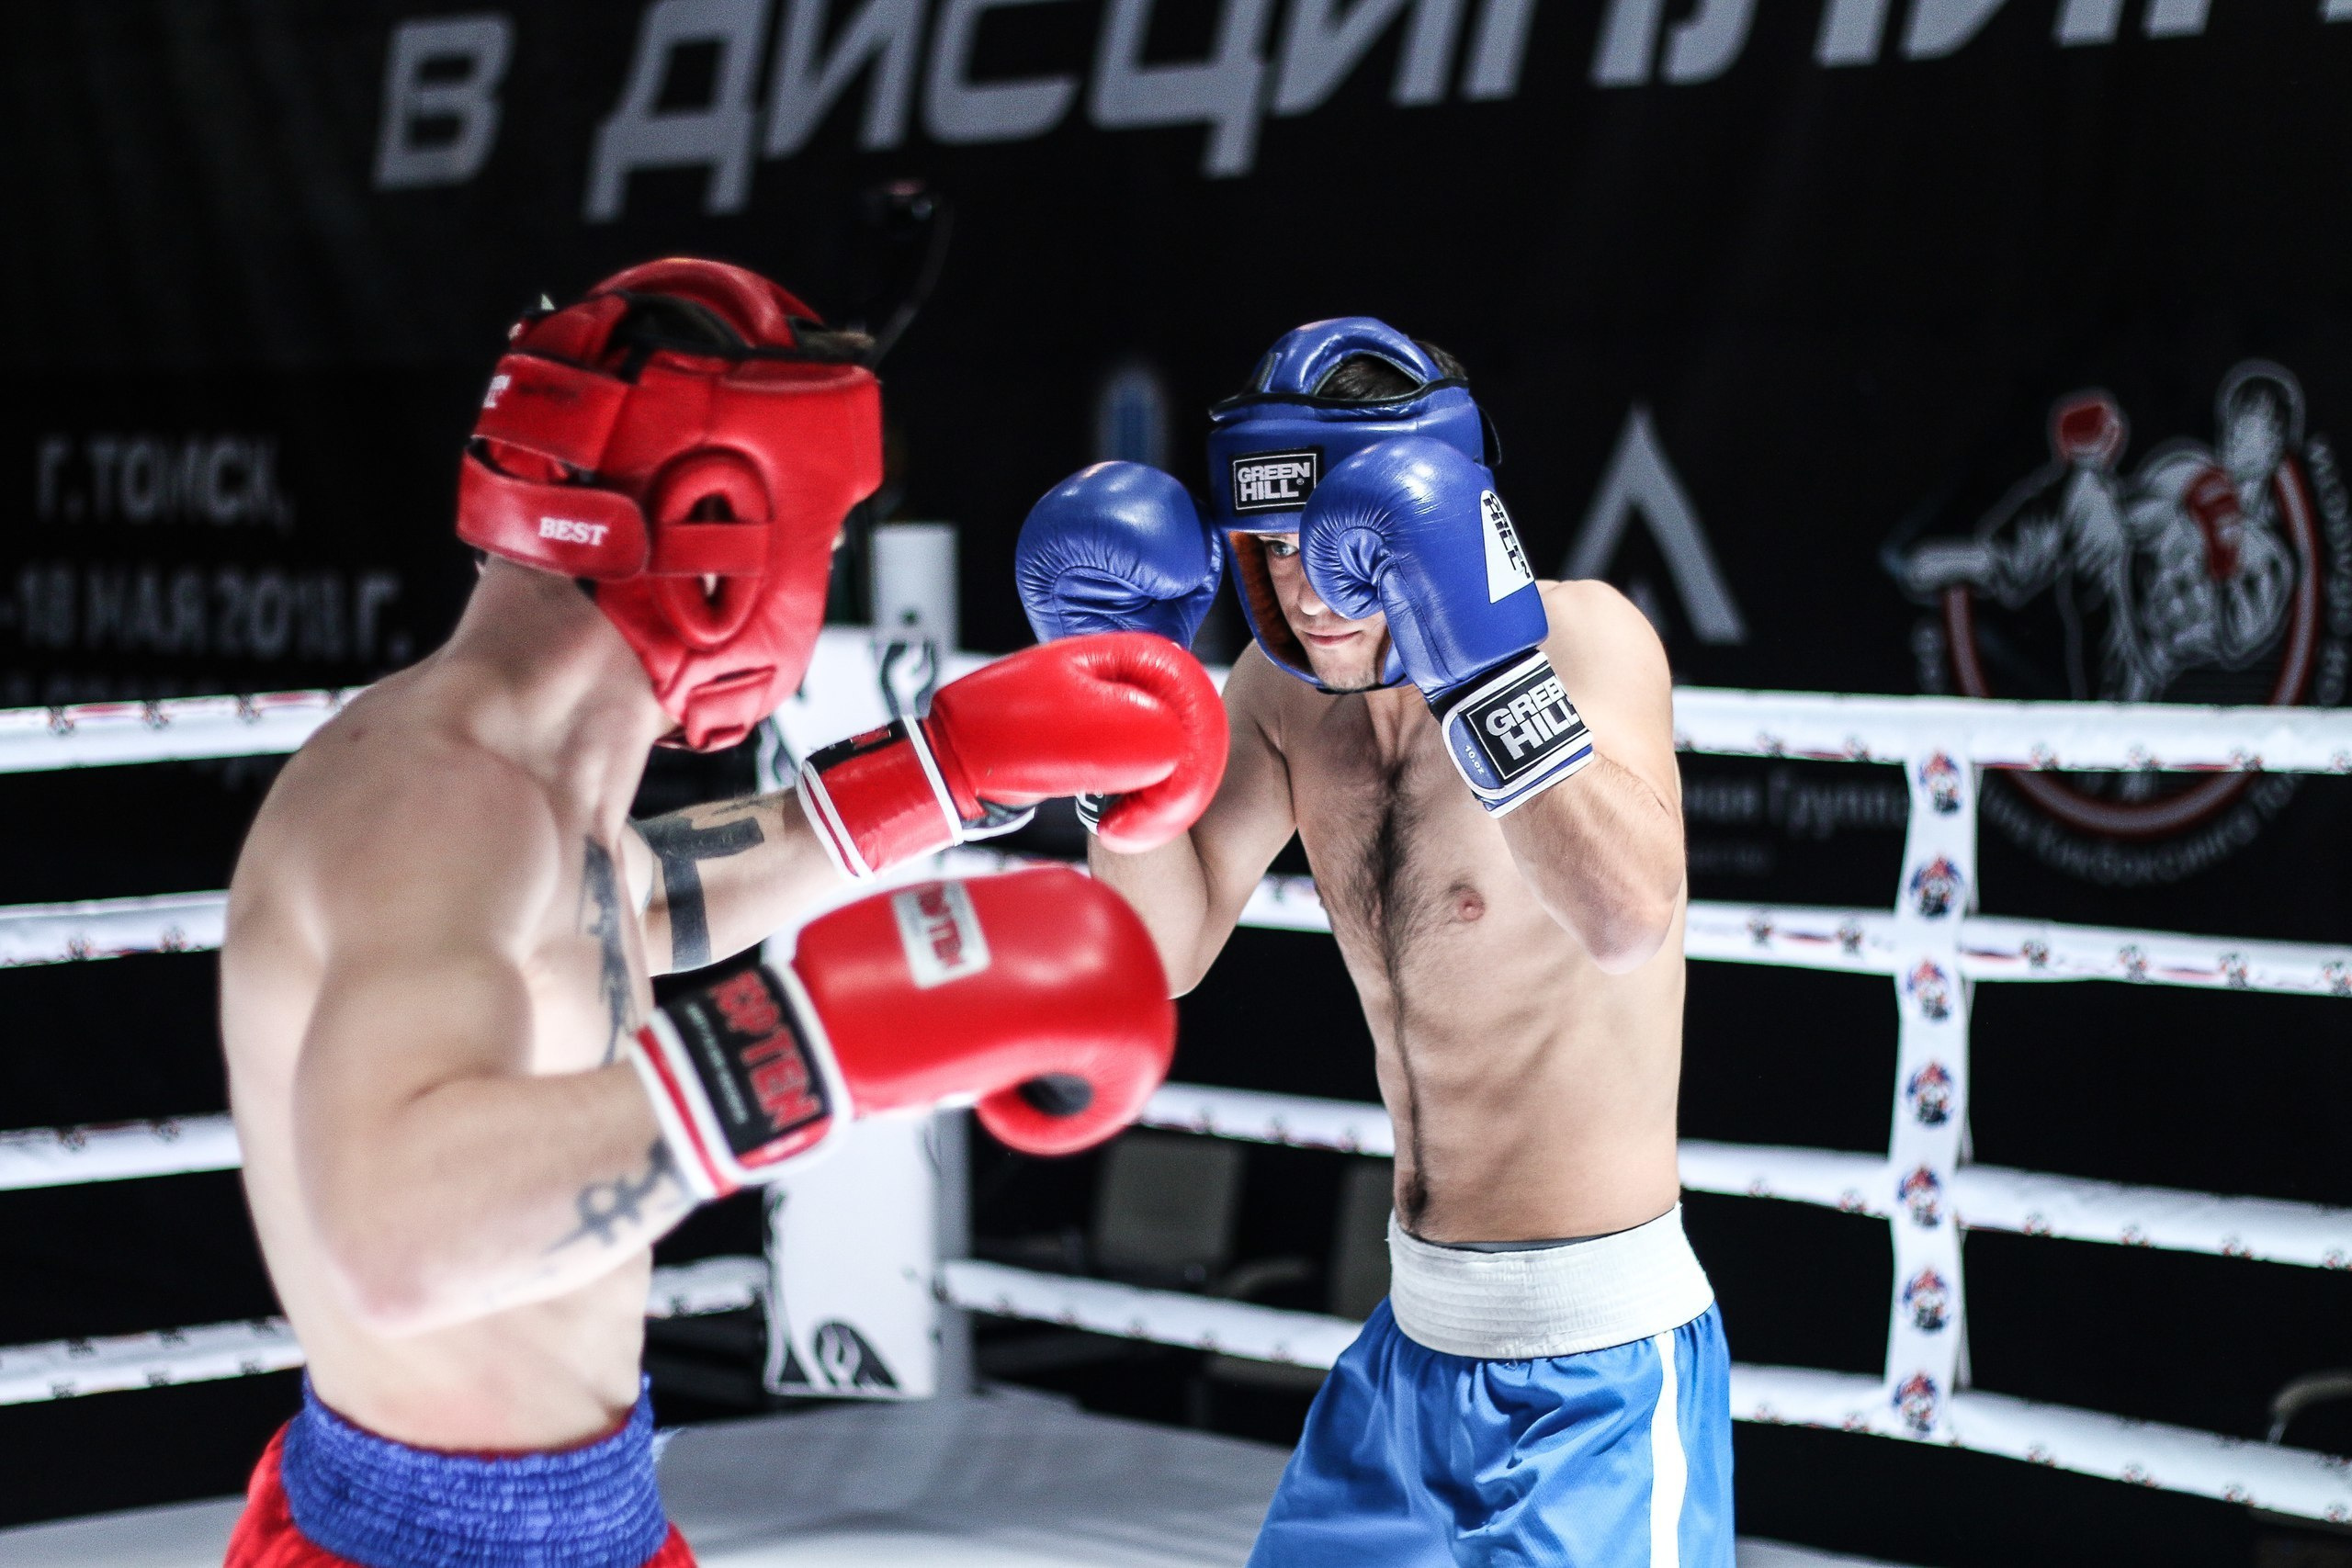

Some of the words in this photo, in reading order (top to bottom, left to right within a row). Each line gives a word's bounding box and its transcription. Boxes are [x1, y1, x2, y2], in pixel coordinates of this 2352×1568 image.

[372, 13, 514, 189] В
[582, 0, 2352, 223] ДИСЦИ
[1237, 462, 1311, 484] GREEN
[1239, 479, 1299, 502] HILL
[538, 517, 609, 547] BEST
[1482, 497, 1517, 571] HILL
[1486, 675, 1567, 737] GREE
[1499, 697, 1580, 761] HILL
